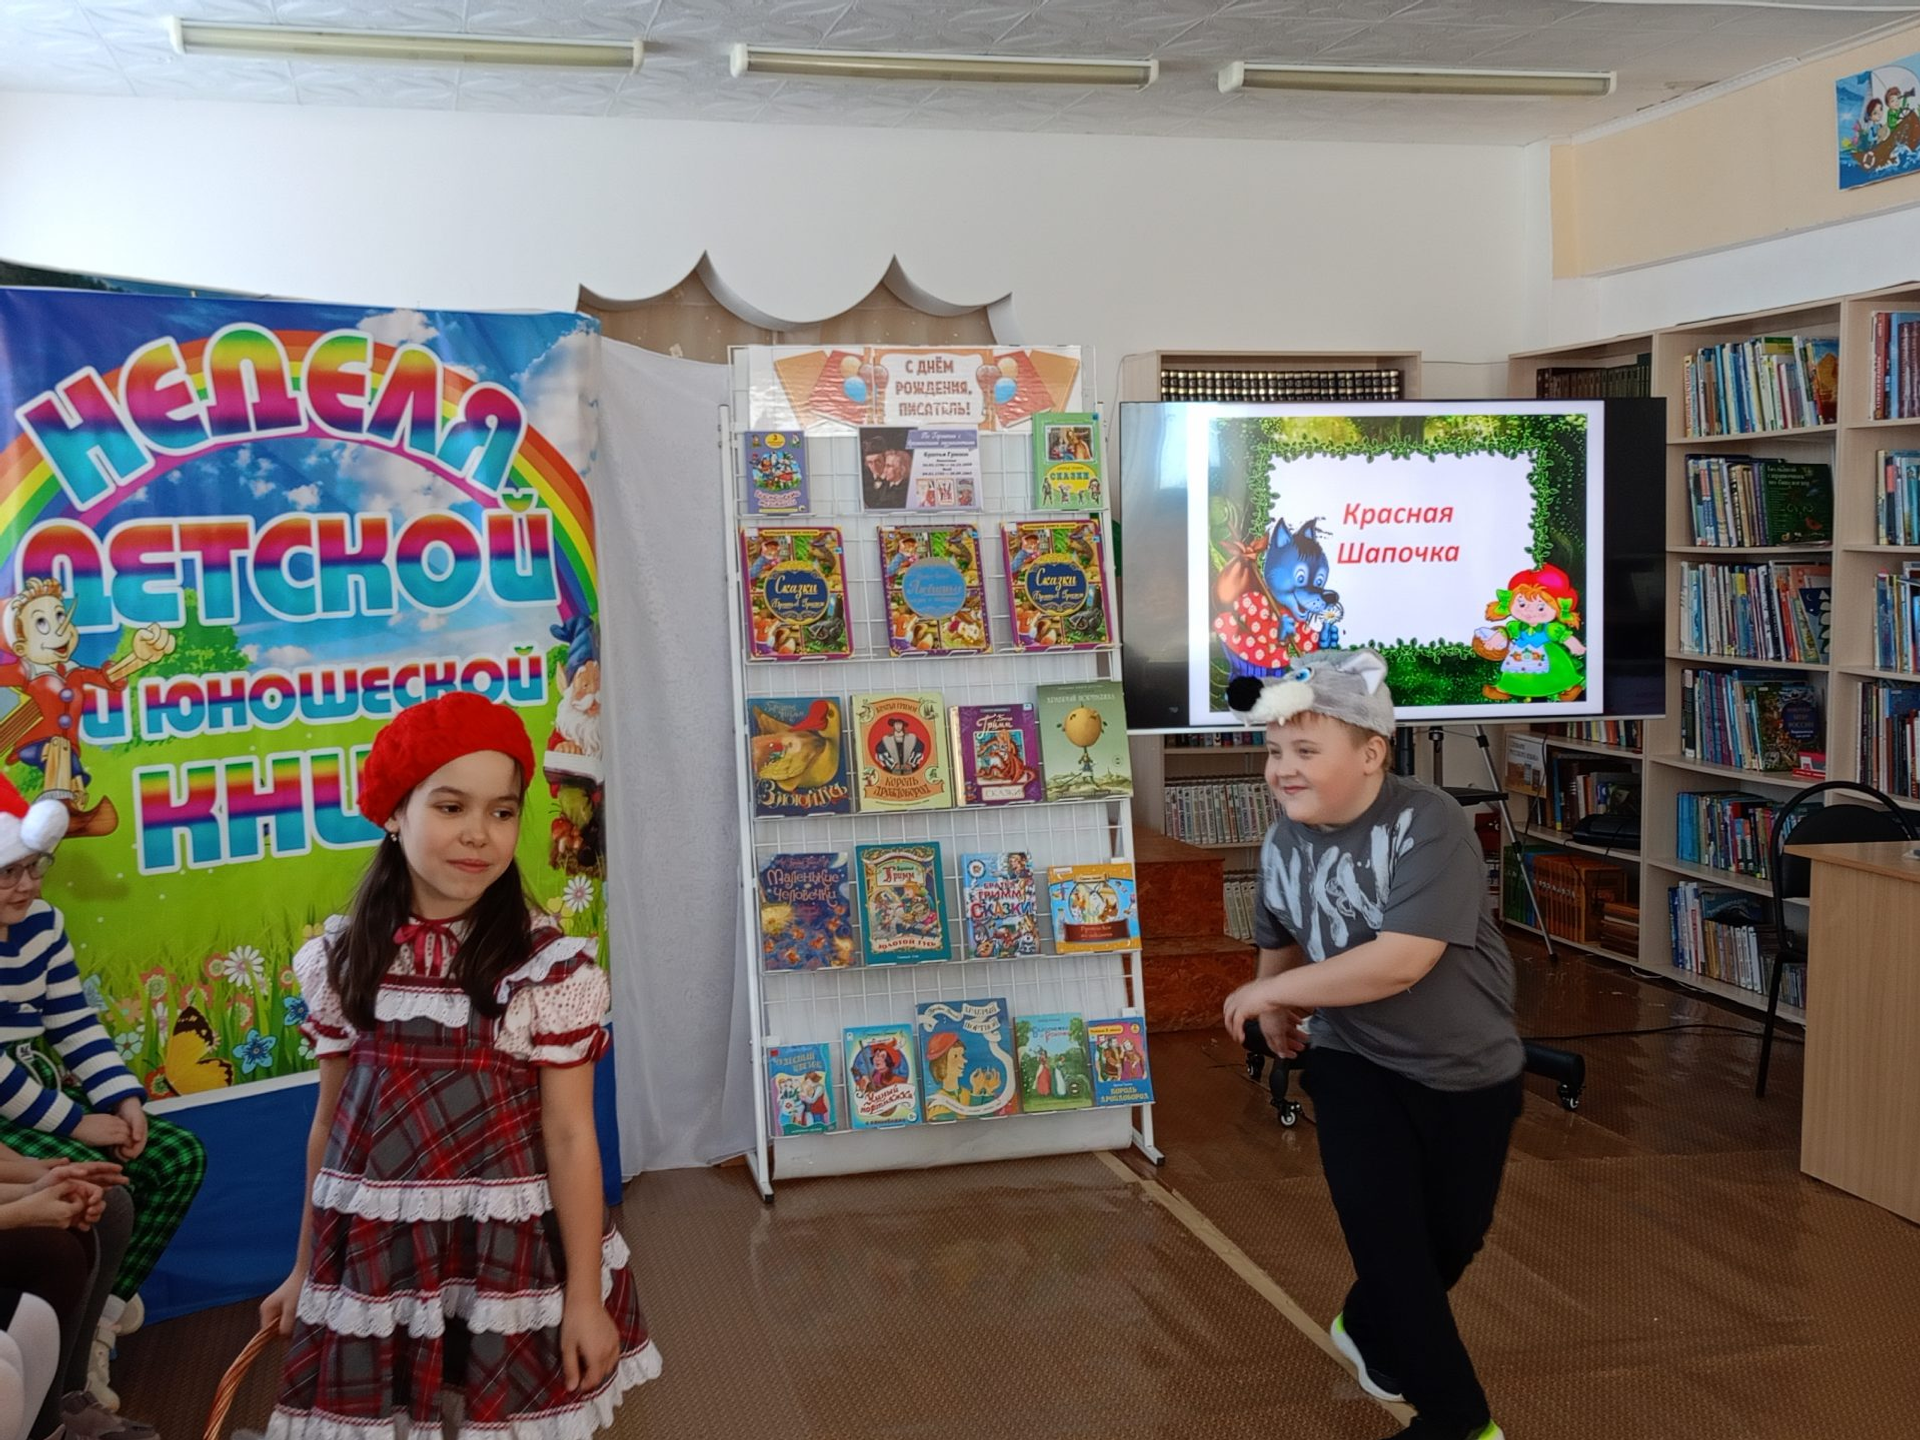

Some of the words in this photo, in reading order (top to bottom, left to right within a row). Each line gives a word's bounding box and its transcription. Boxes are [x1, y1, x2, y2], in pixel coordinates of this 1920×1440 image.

[905, 360, 914, 374] С
[917, 356, 954, 375] ДНЁМ
[15, 322, 528, 511] НЕДЕЛЯ
[899, 402, 971, 416] ПИСАТЕЛЬ!
[1050, 472, 1089, 480] СКАЗКИ
[1342, 502, 1454, 528] Красная
[16, 488, 561, 632] ДЕТСКОЙ
[1336, 540, 1461, 566] Шапочка
[775, 575, 818, 599] Сказки
[1036, 568, 1077, 591] Сказки
[139, 643, 550, 740] ЮНОШЕСКОЙ
[133, 744, 384, 875] КНИ
[767, 868, 840, 889] Маленькие
[979, 890, 1021, 899] ГРИММ
